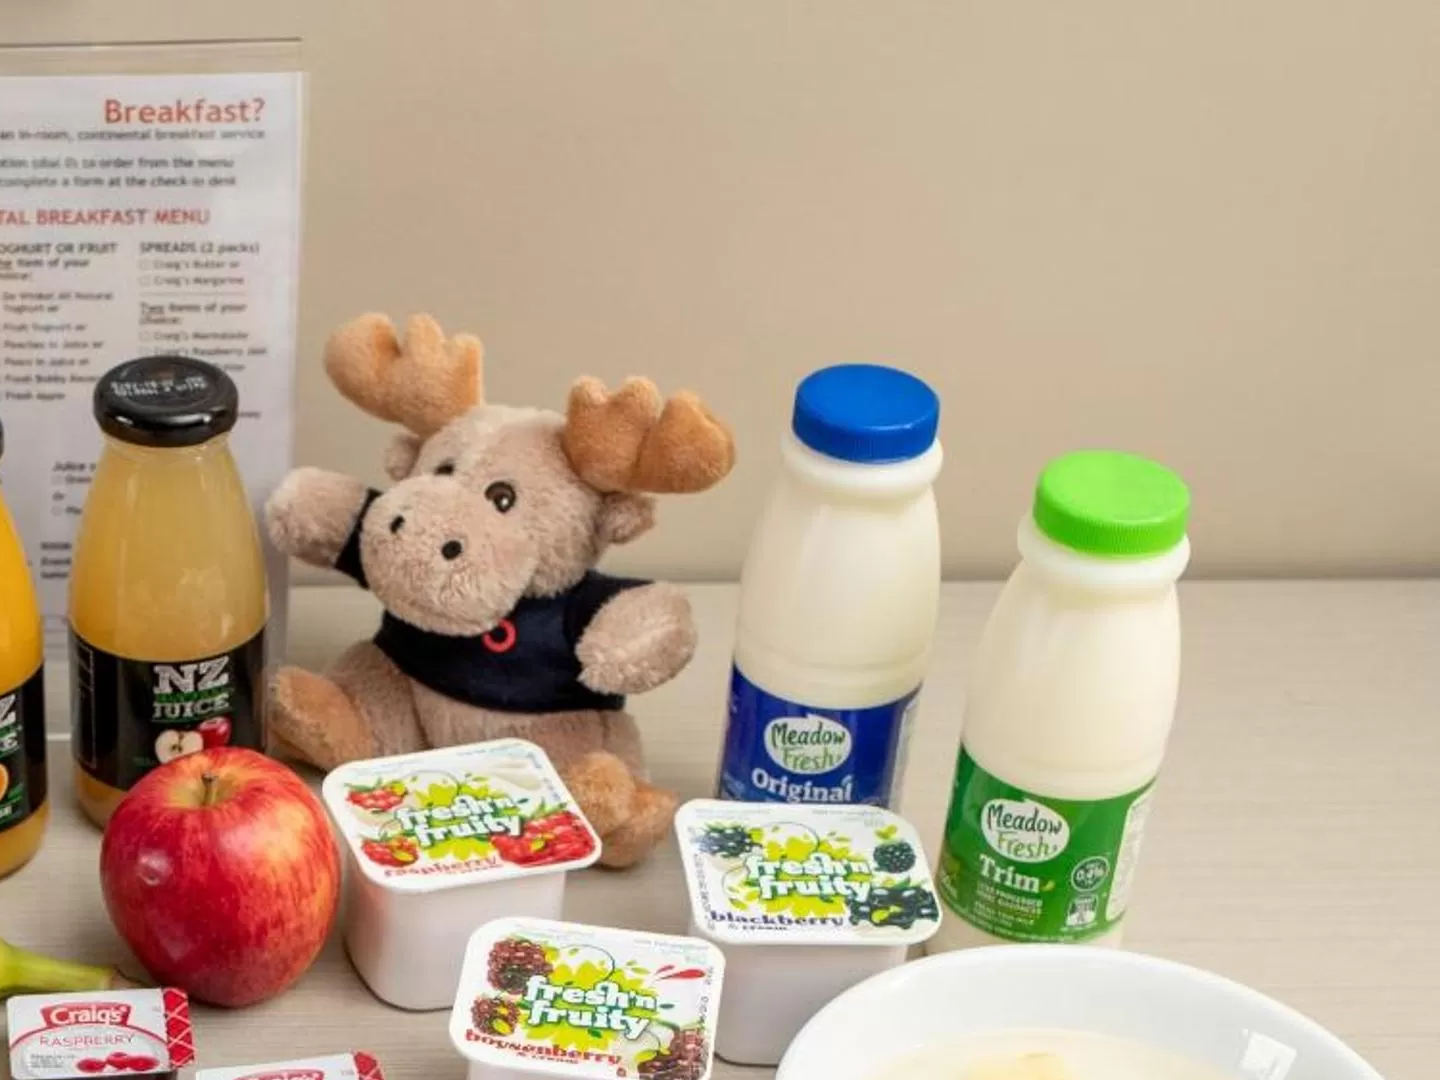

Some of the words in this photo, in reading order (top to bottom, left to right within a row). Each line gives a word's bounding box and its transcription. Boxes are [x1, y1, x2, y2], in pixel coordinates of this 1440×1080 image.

[103, 98, 265, 124] Breakfast?
[0, 131, 14, 140] an
[77, 129, 150, 141] continental
[155, 129, 214, 140] breakfast
[221, 129, 265, 140] service
[99, 157, 133, 168] order
[139, 157, 168, 168] from
[173, 157, 193, 168] the
[197, 158, 233, 168] menu
[74, 176, 104, 187] form
[108, 177, 120, 187] at
[126, 176, 146, 187] the
[209, 175, 235, 186] desk
[36, 208, 147, 226] BREAKFAST
[154, 208, 210, 226] MENU
[55, 242, 74, 253] OR
[79, 242, 118, 253] FRUIT
[139, 242, 196, 253] SPREADS
[218, 242, 260, 255] packs)
[47, 258, 59, 267] of
[63, 258, 91, 269] your
[153, 656, 229, 694] NZ
[152, 693, 230, 718] JUICE
[771, 721, 847, 748] Meadow
[782, 745, 833, 770] Fresh
[751, 767, 854, 803] Original
[414, 815, 522, 847] fruity
[987, 803, 1063, 835] Meadow
[997, 830, 1050, 858] Fresh
[384, 857, 497, 877] raspberry
[979, 854, 1040, 892] Trim
[759, 875, 871, 902] fruity
[708, 911, 844, 927] blackberry
[51, 1004, 127, 1026] Craig's
[528, 1001, 650, 1040] fruity
[39, 1034, 136, 1047] RASPBERRY
[465, 1029, 623, 1066] boysenberry
